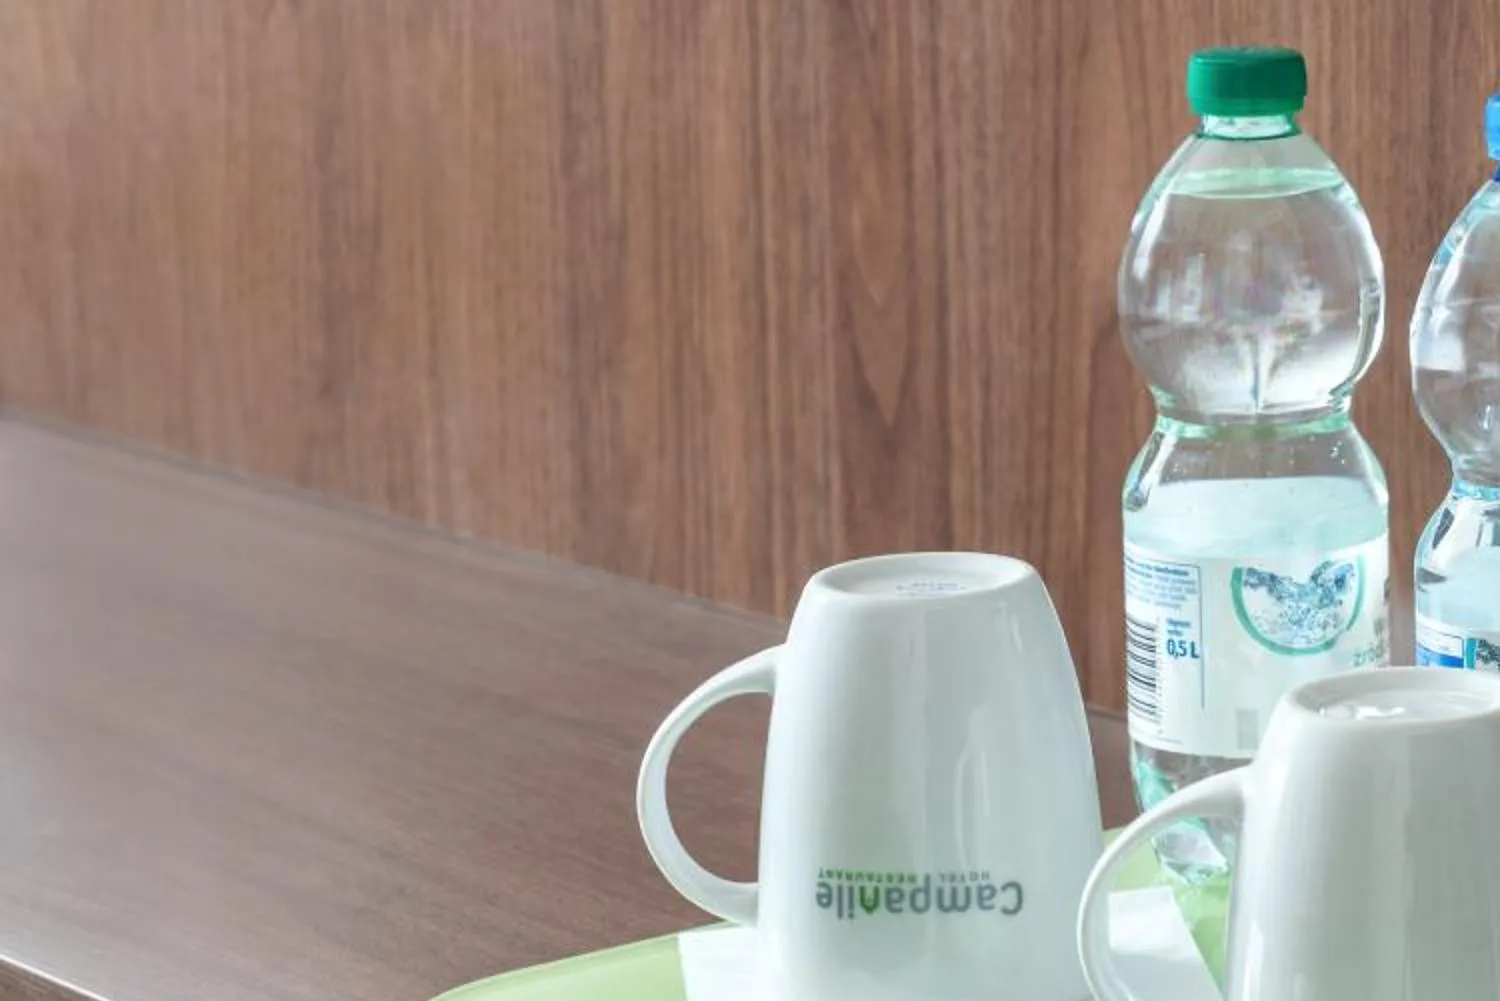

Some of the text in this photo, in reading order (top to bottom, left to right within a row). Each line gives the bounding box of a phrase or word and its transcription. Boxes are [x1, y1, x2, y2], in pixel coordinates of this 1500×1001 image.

[1167, 639, 1199, 659] 0,5 L
[940, 870, 990, 883] HOTEL
[815, 873, 1023, 919] Campanile
